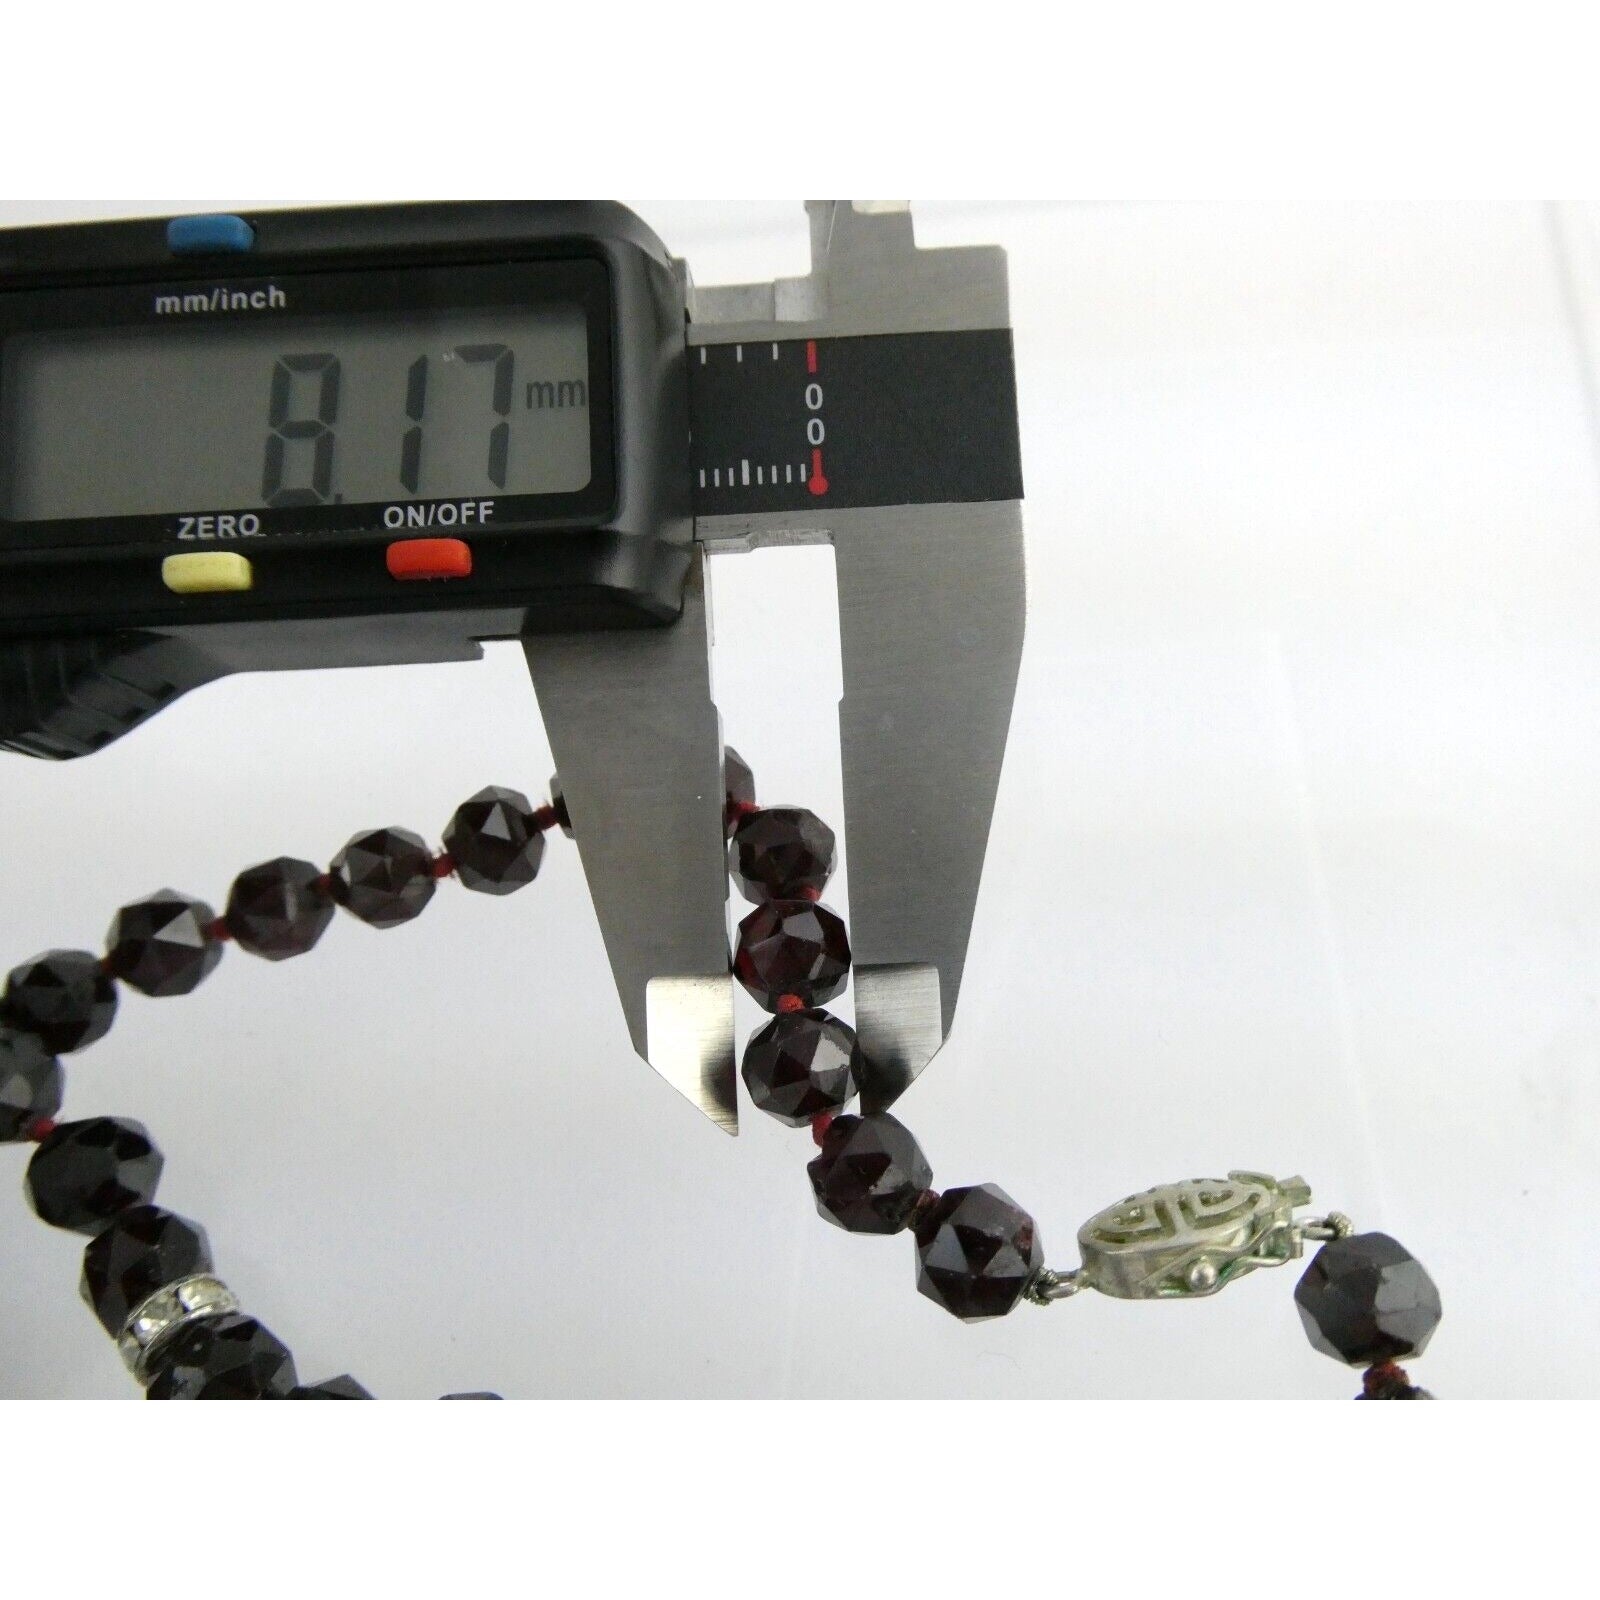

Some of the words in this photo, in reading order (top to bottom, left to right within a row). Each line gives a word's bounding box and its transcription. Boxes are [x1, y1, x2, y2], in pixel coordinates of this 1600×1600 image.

[154, 284, 287, 314] mm/inch
[805, 383, 824, 410] 0
[260, 343, 515, 508] 8.17
[525, 377, 587, 410] mm
[806, 418, 826, 445] 0
[177, 514, 261, 540] ZERO
[383, 501, 495, 528] ON/OFF
